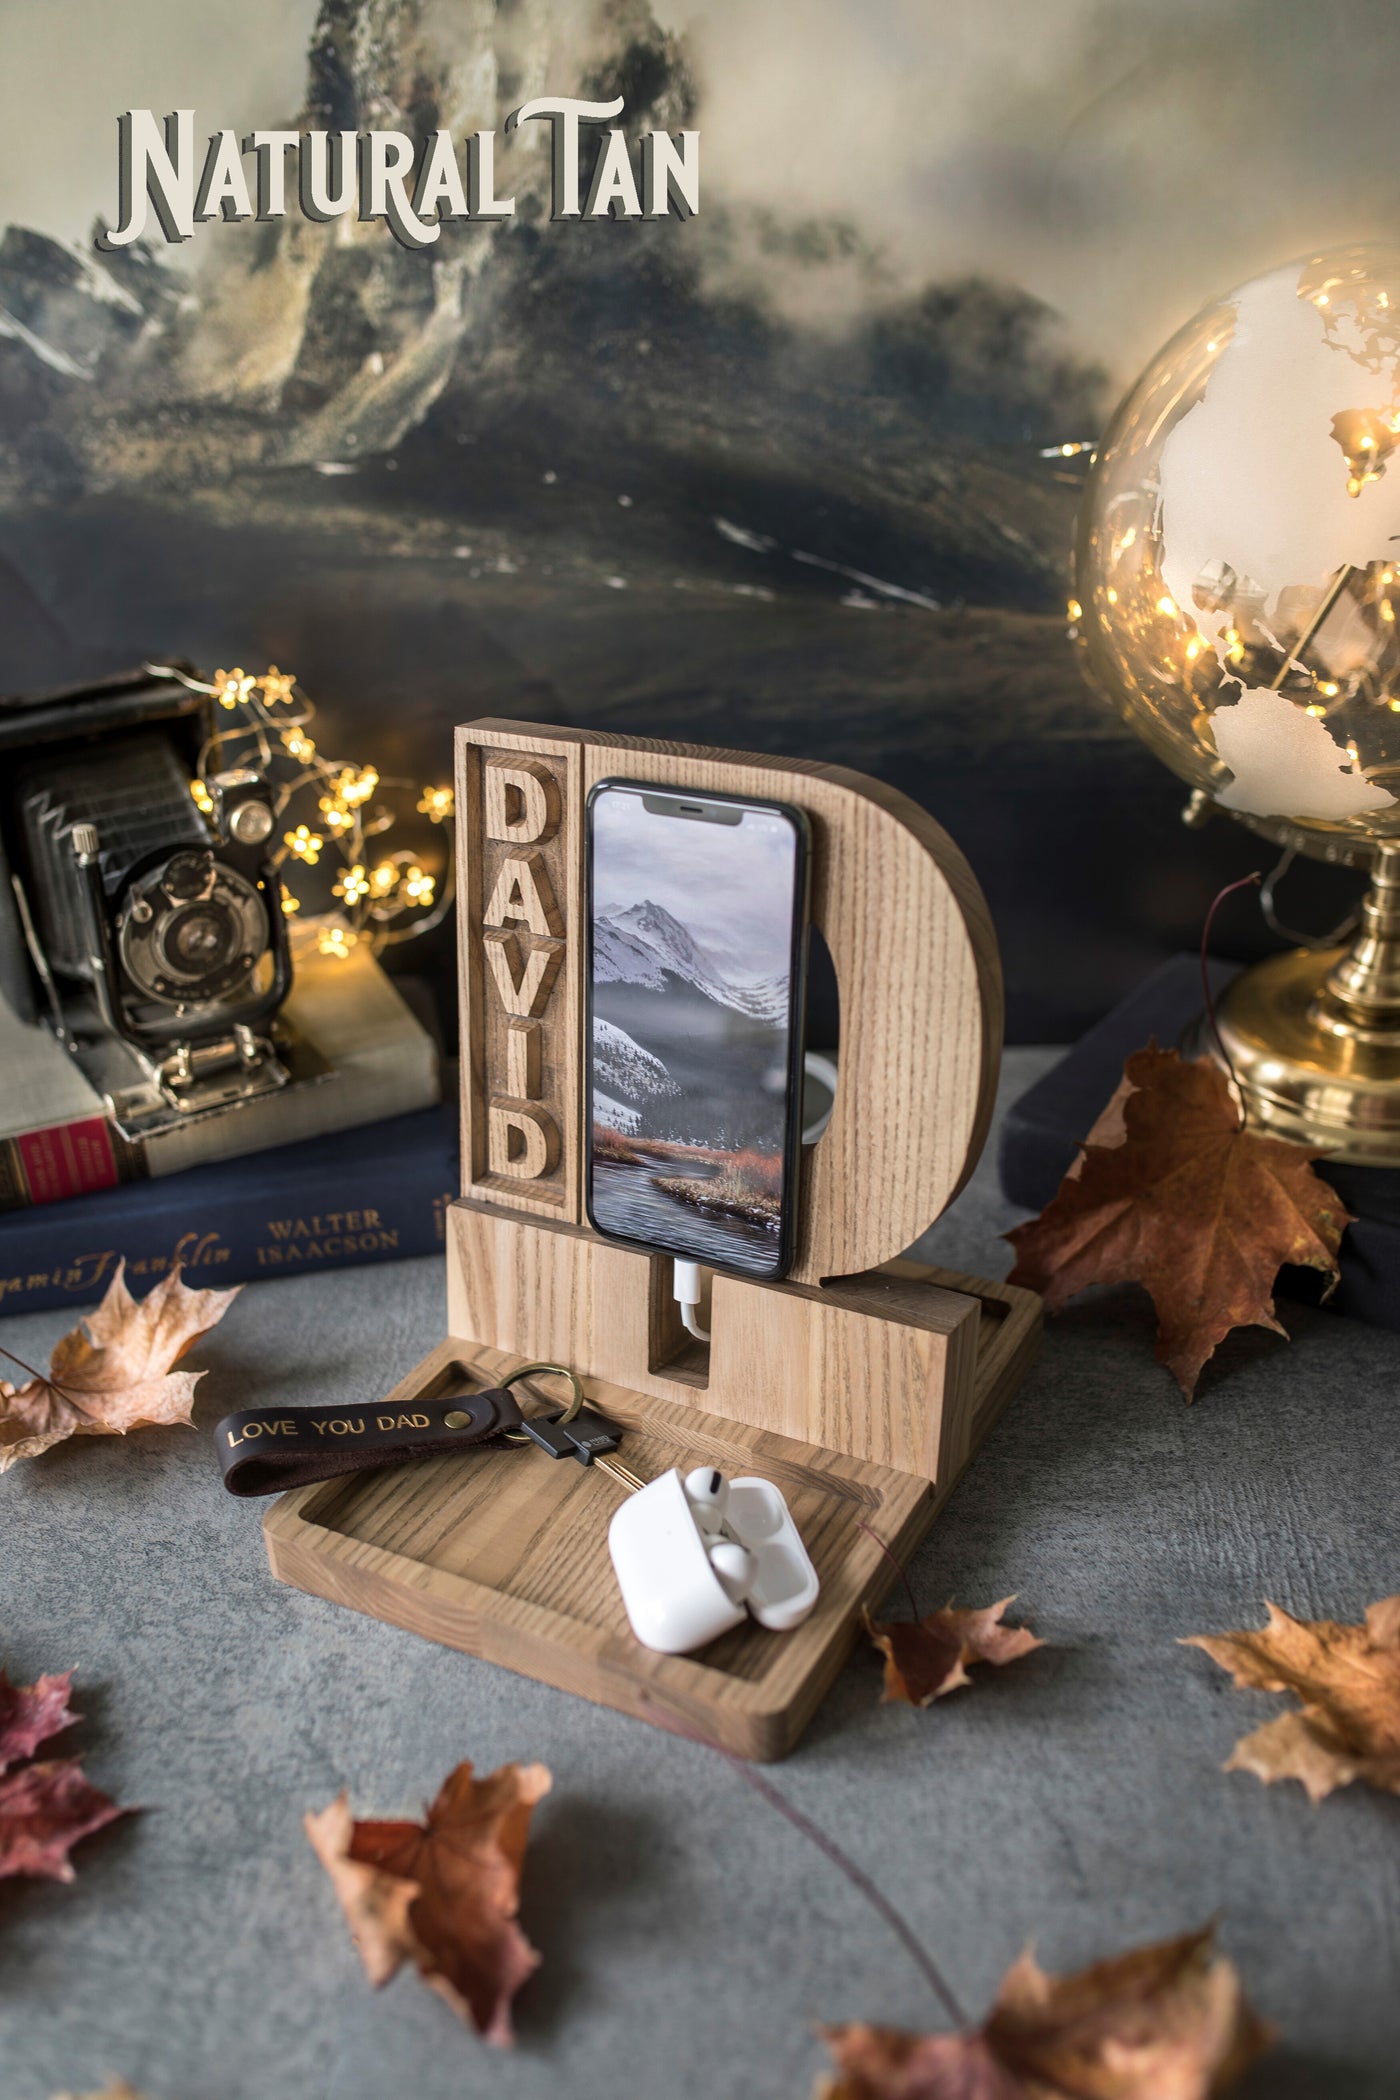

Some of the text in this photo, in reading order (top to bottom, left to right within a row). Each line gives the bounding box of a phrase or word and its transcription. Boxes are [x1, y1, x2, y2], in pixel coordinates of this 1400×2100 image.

[482, 756, 566, 1180] DAVID
[267, 1208, 384, 1242] WALTER
[64, 1232, 231, 1292] Fanklin
[256, 1229, 400, 1266] ISAACSON
[226, 1413, 431, 1449] LOVE YOU DAD
